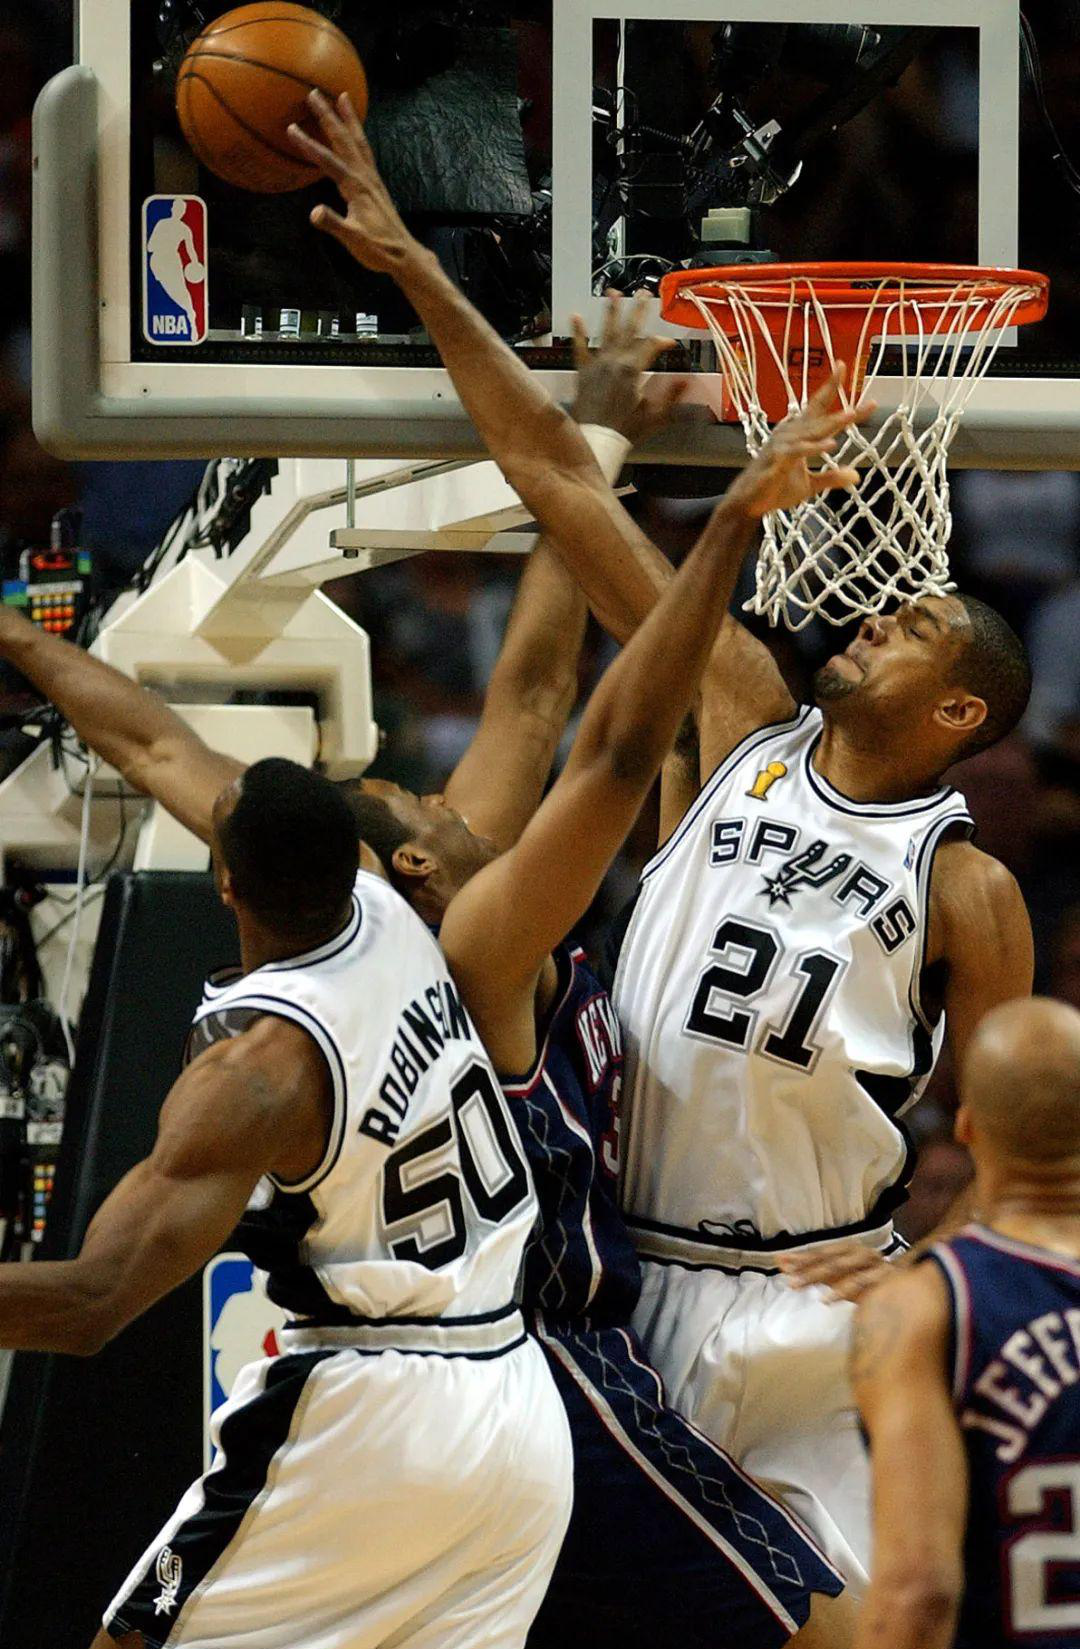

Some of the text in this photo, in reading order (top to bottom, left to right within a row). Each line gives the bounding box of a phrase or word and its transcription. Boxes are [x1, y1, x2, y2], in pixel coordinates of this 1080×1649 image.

[152, 315, 188, 335] NBA
[709, 816, 917, 957] SPURS
[681, 913, 849, 1077] 21
[379, 1053, 538, 1272] 50
